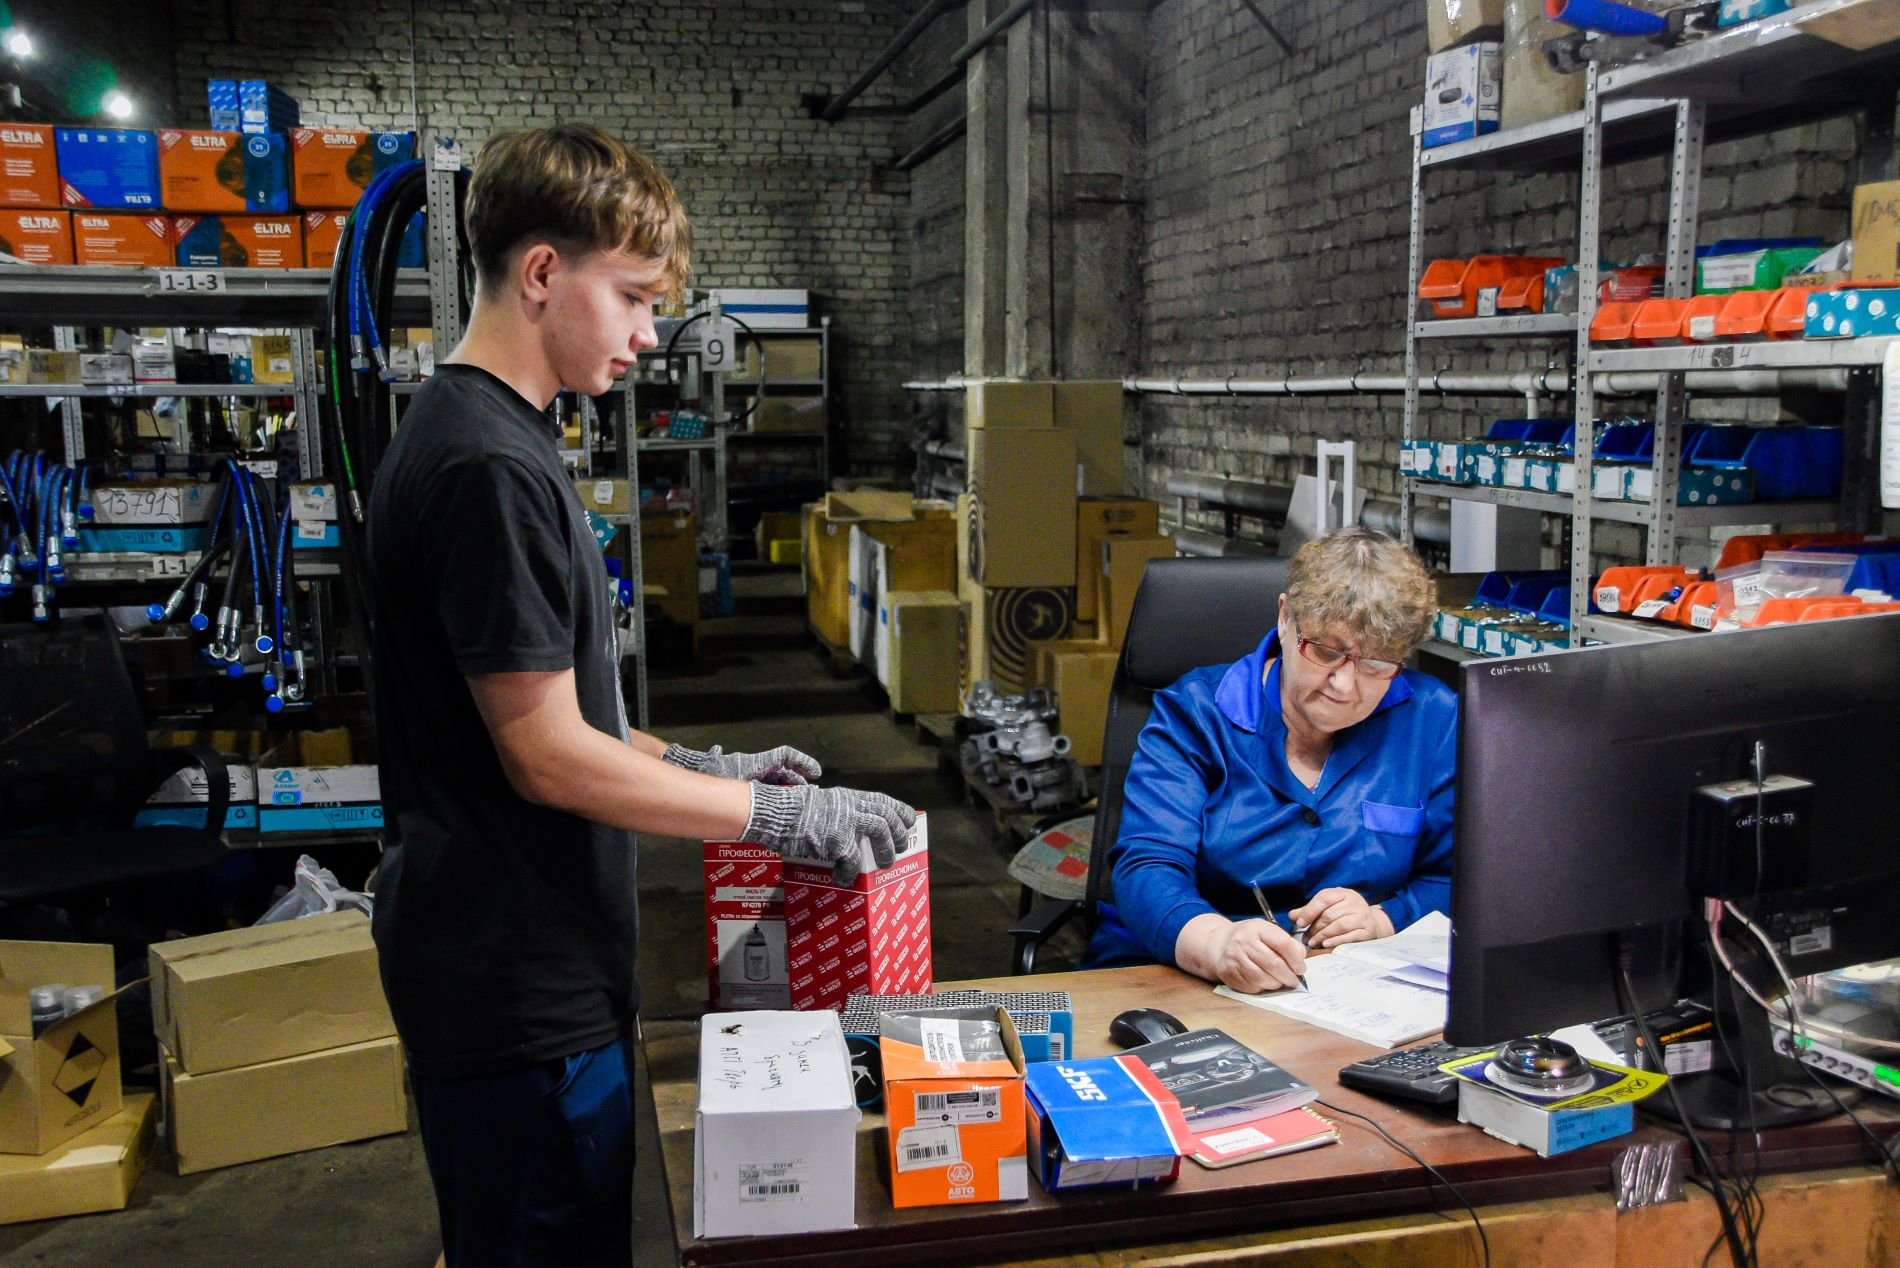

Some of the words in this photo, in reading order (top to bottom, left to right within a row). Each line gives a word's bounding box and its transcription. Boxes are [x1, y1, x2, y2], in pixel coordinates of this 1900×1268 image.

[0, 129, 44, 145] ELTRA
[190, 136, 227, 147] ELTRA
[322, 133, 357, 145] ELTRA
[124, 195, 152, 204] ELTRA
[18, 216, 61, 229] ELTRA
[81, 218, 110, 227] ELTRA
[253, 223, 292, 234] ELTRA
[164, 273, 219, 291] 1-1-3
[706, 338, 725, 366] 9
[875, 860, 919, 886] ПРОФЕССИОНАЛ
[1056, 1065, 1108, 1101] SKF
